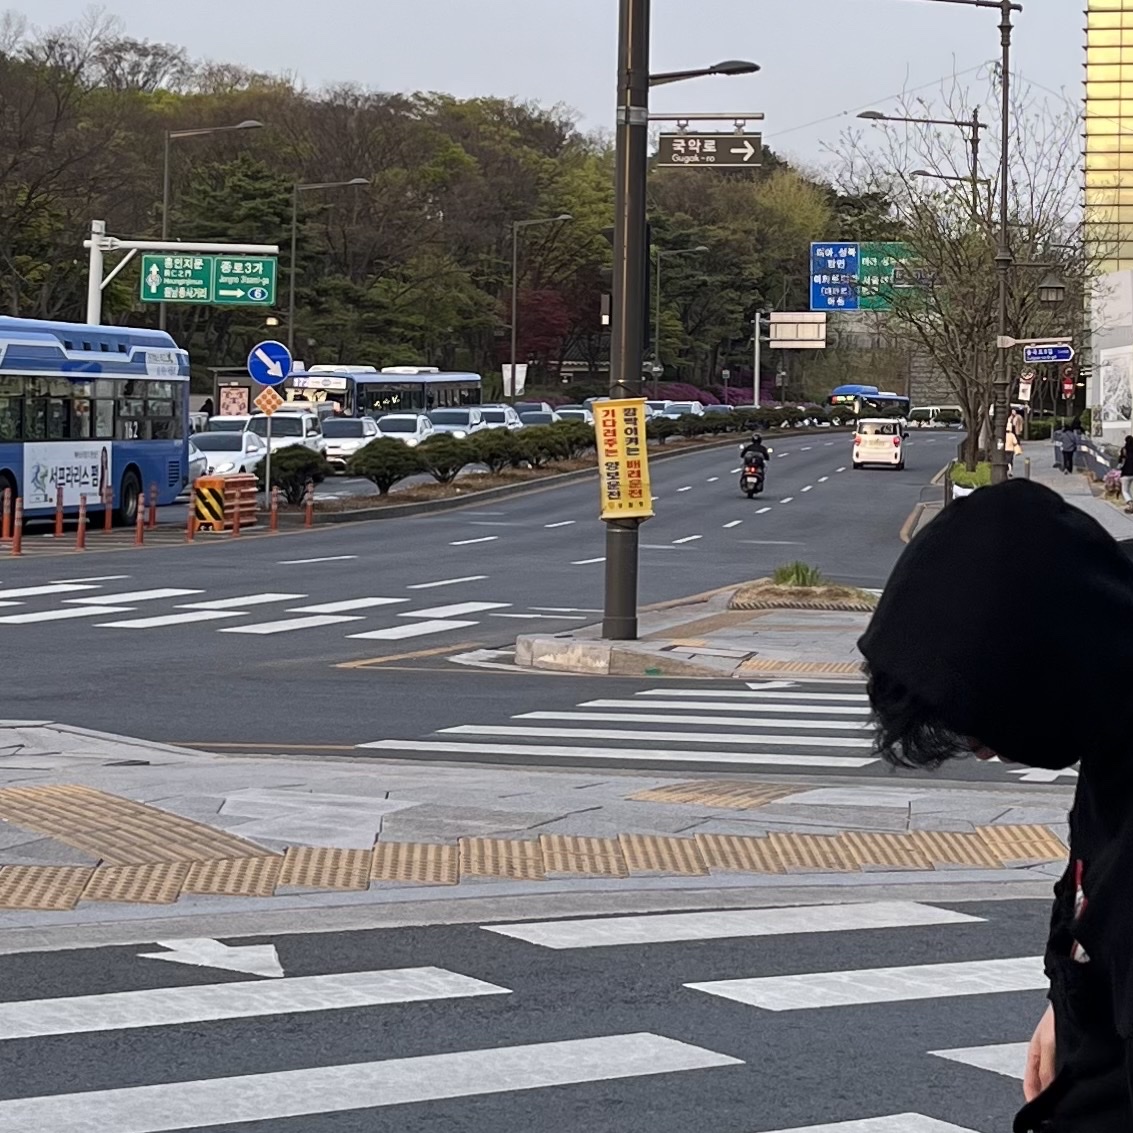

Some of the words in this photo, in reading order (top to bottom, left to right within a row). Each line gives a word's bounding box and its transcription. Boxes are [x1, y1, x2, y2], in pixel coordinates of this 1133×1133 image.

[672, 139, 717, 153] 국악로
[164, 257, 204, 270] 흥인지문
[220, 260, 263, 275] 종로3가
[254, 287, 262, 299] 6
[49, 465, 89, 489] 서프라리스
[626, 460, 643, 499] 배려운전
